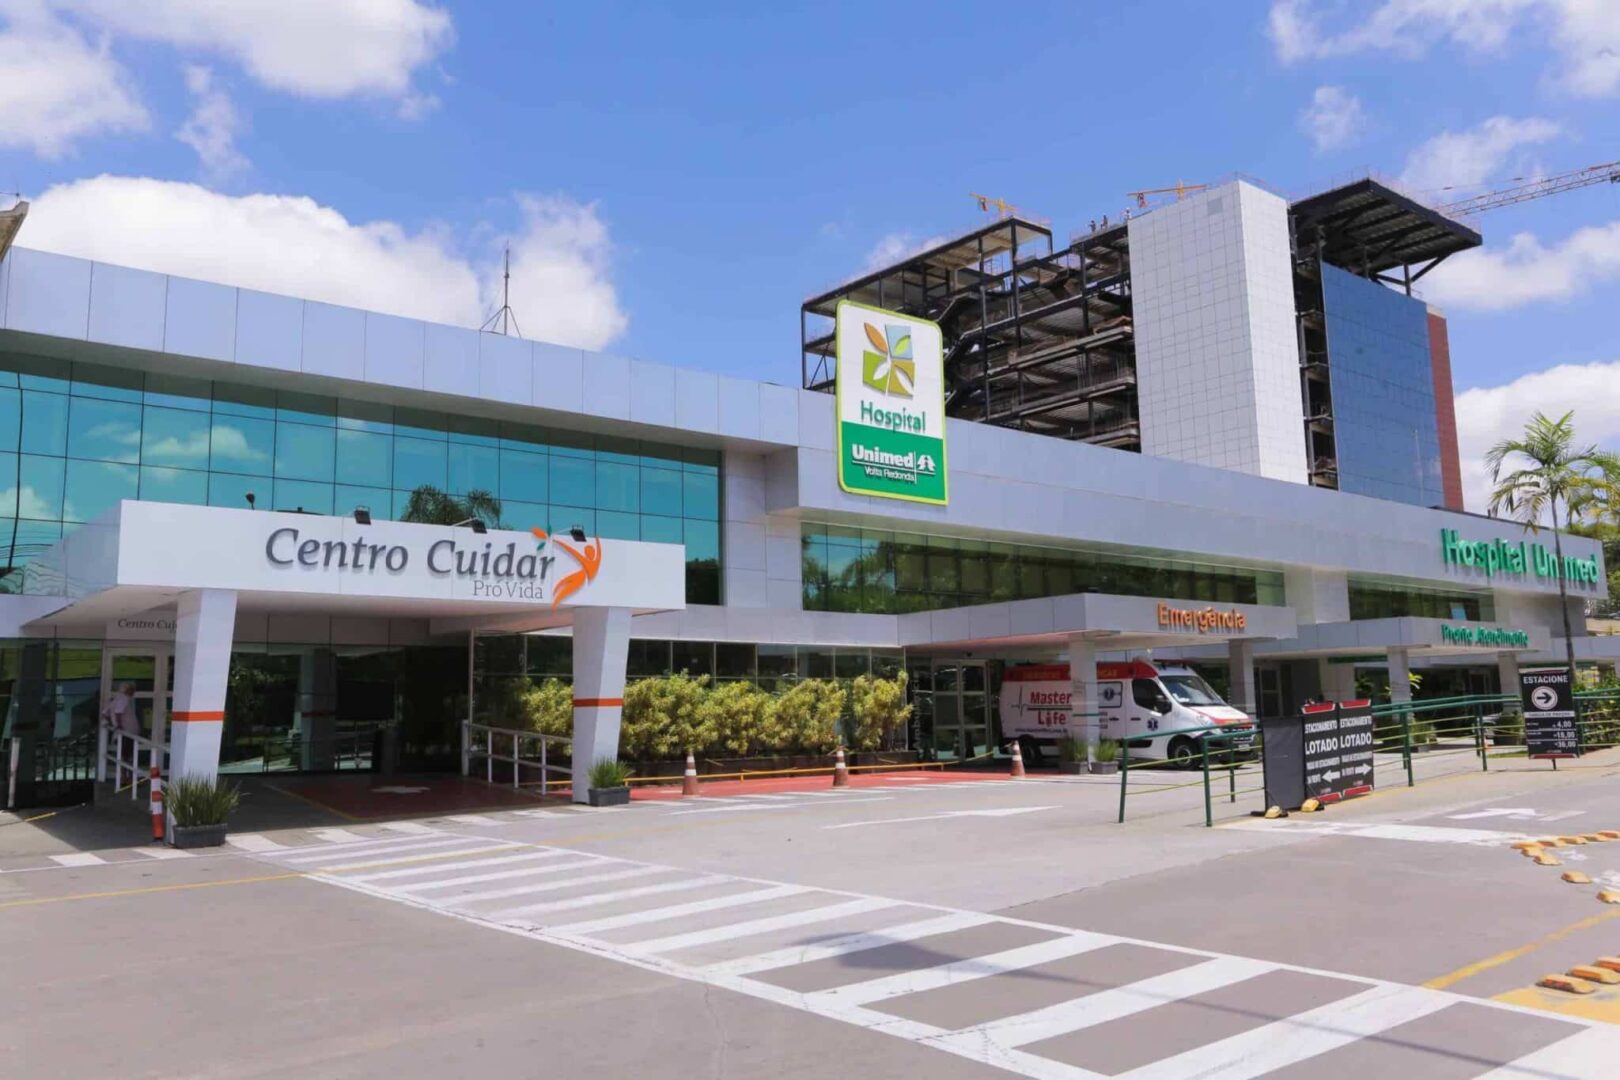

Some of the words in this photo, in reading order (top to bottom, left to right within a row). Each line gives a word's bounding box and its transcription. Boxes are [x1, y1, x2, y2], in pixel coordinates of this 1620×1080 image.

[861, 400, 926, 433] Hospital
[852, 443, 914, 467] Unimed
[865, 466, 882, 477] Volta
[884, 468, 914, 481] Redonda
[265, 528, 408, 571] Centro
[426, 539, 555, 579] Cuidar
[1441, 528, 1527, 577] Hospital
[1532, 543, 1599, 583] Unmed
[473, 580, 502, 597] Pró
[507, 581, 543, 599] Vida
[118, 618, 154, 629] Centro
[1157, 600, 1246, 632] Emergência
[1523, 675, 1568, 684] ESTACIONE
[1030, 691, 1072, 704] Master
[1038, 711, 1066, 727] Life
[1305, 738, 1338, 755] LOTADO
[1340, 732, 1372, 748] LOTADO
